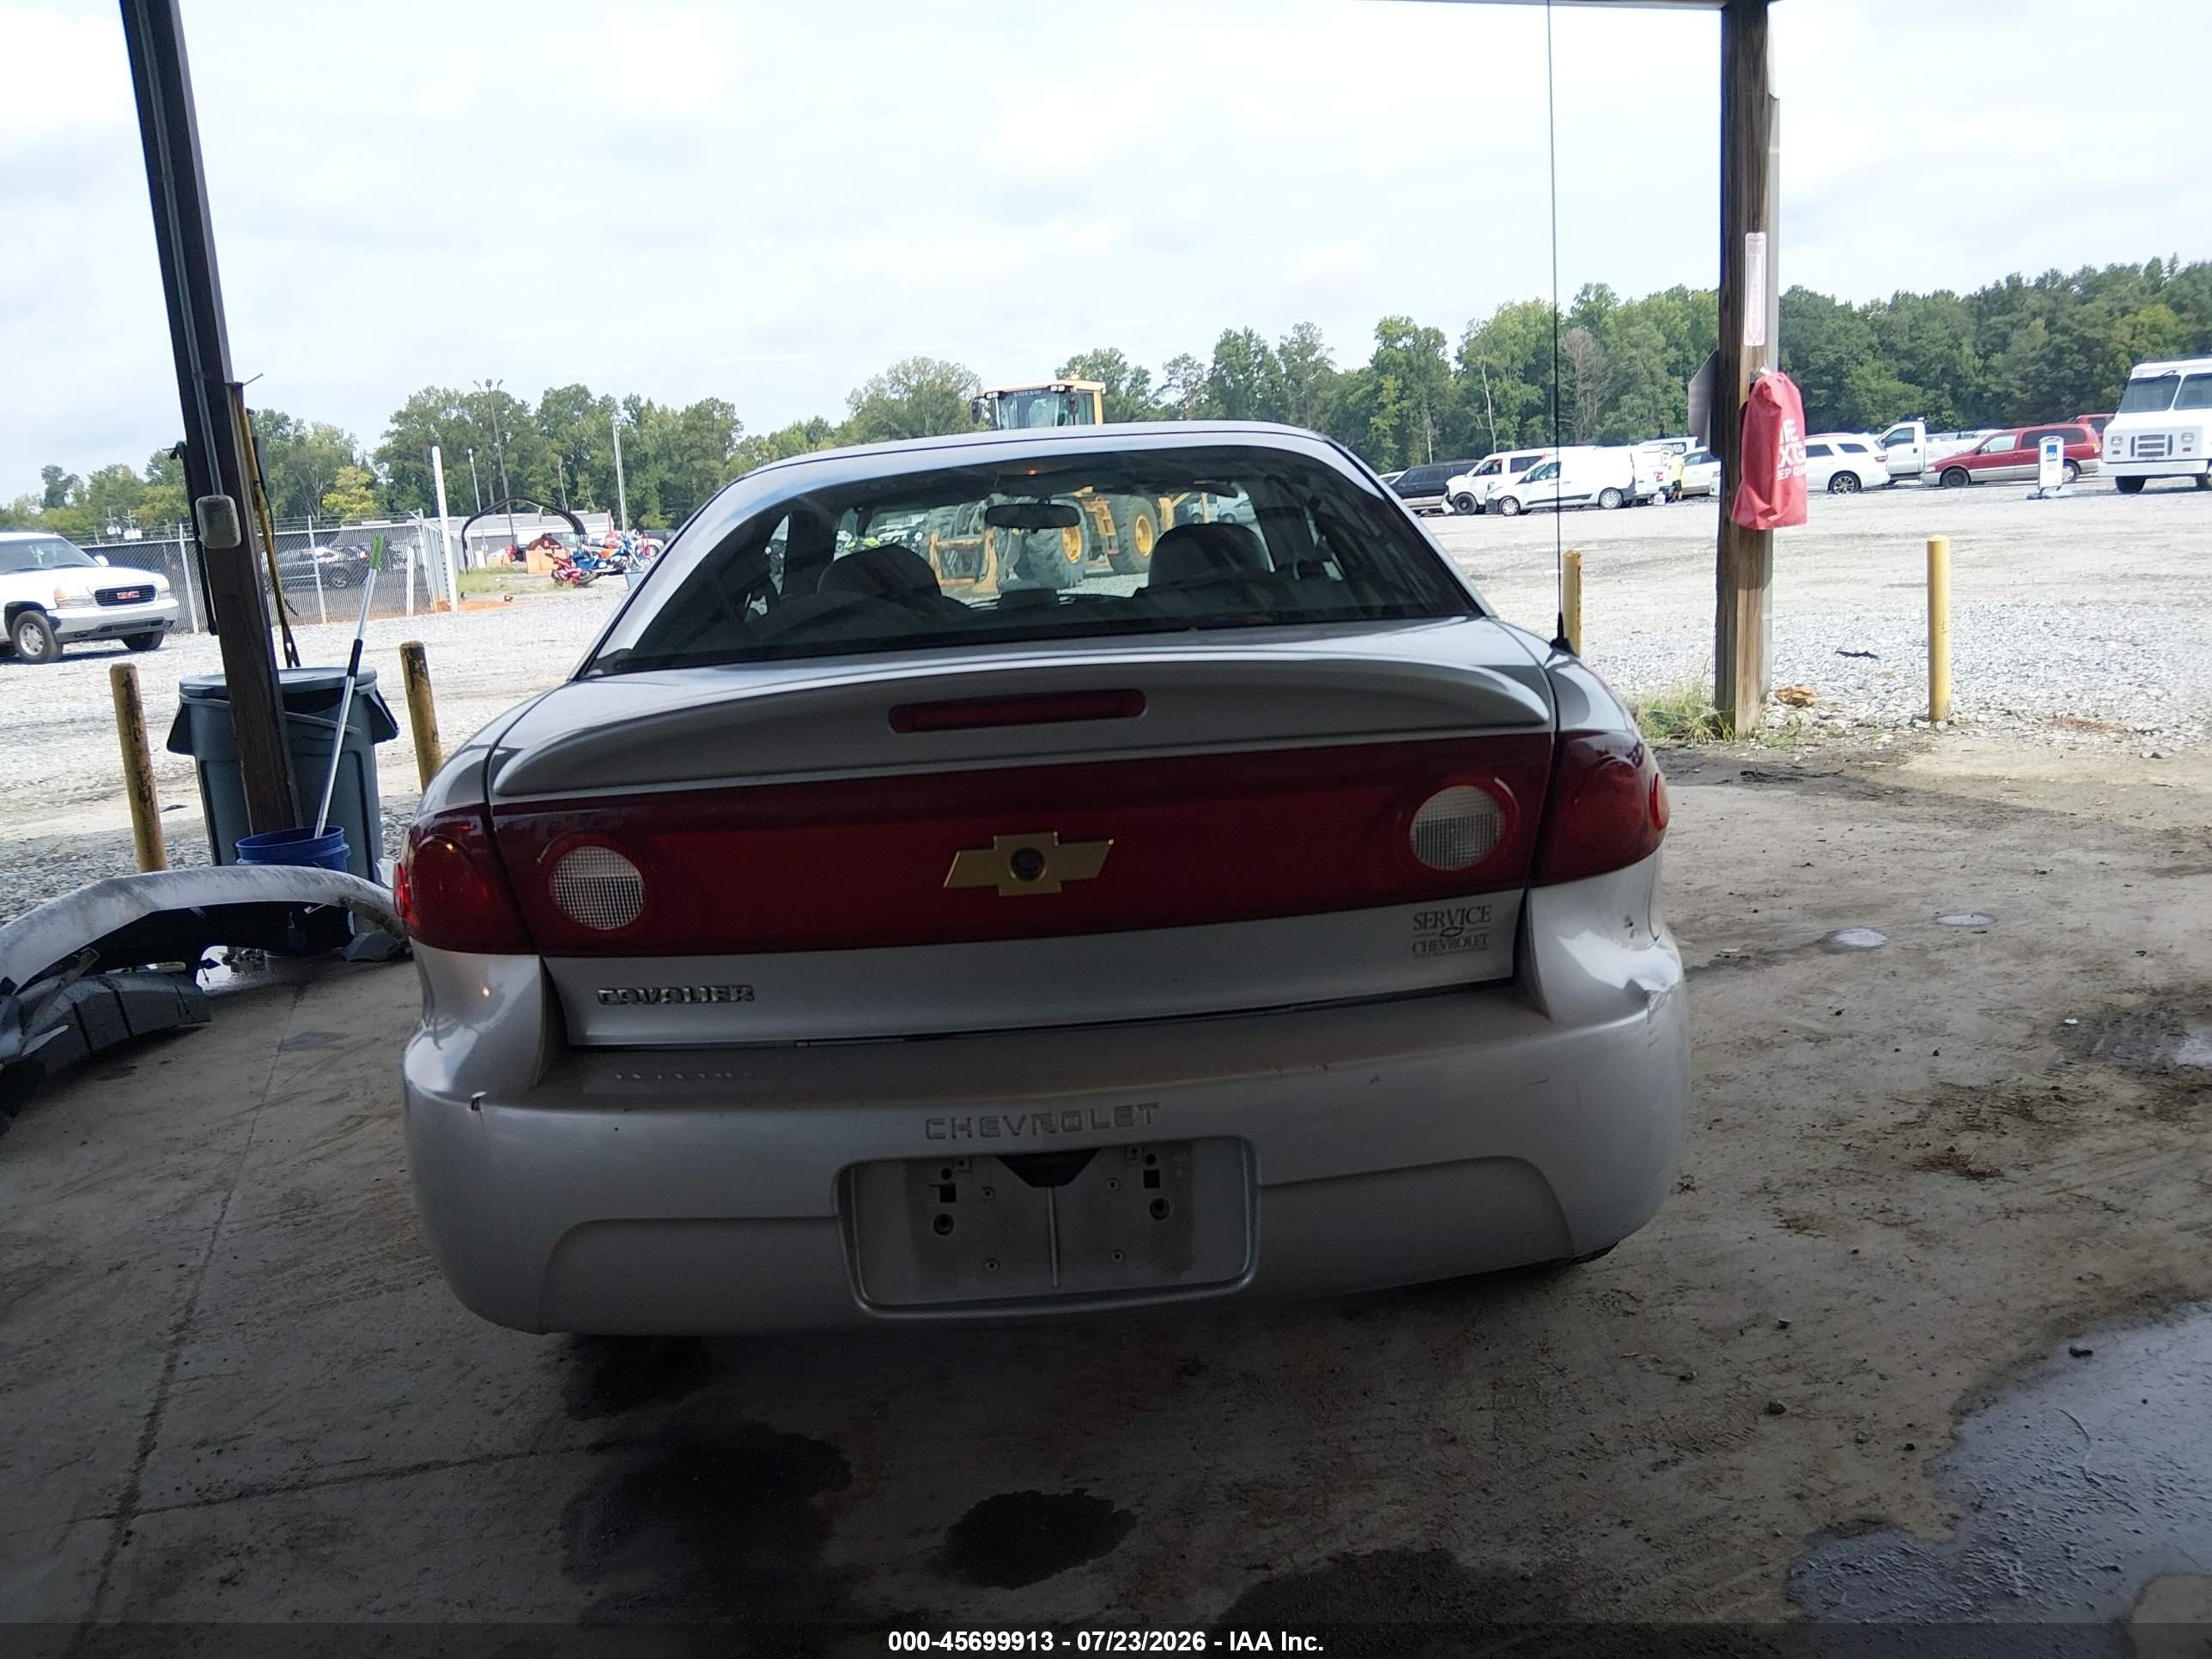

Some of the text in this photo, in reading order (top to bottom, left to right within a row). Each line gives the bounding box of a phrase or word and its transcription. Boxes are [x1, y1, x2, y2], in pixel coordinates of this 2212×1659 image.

[1413, 903, 1492, 931] SERVICE
[597, 984, 755, 1006] CAVALIER
[925, 1102, 1159, 1140] CHEVROLET
